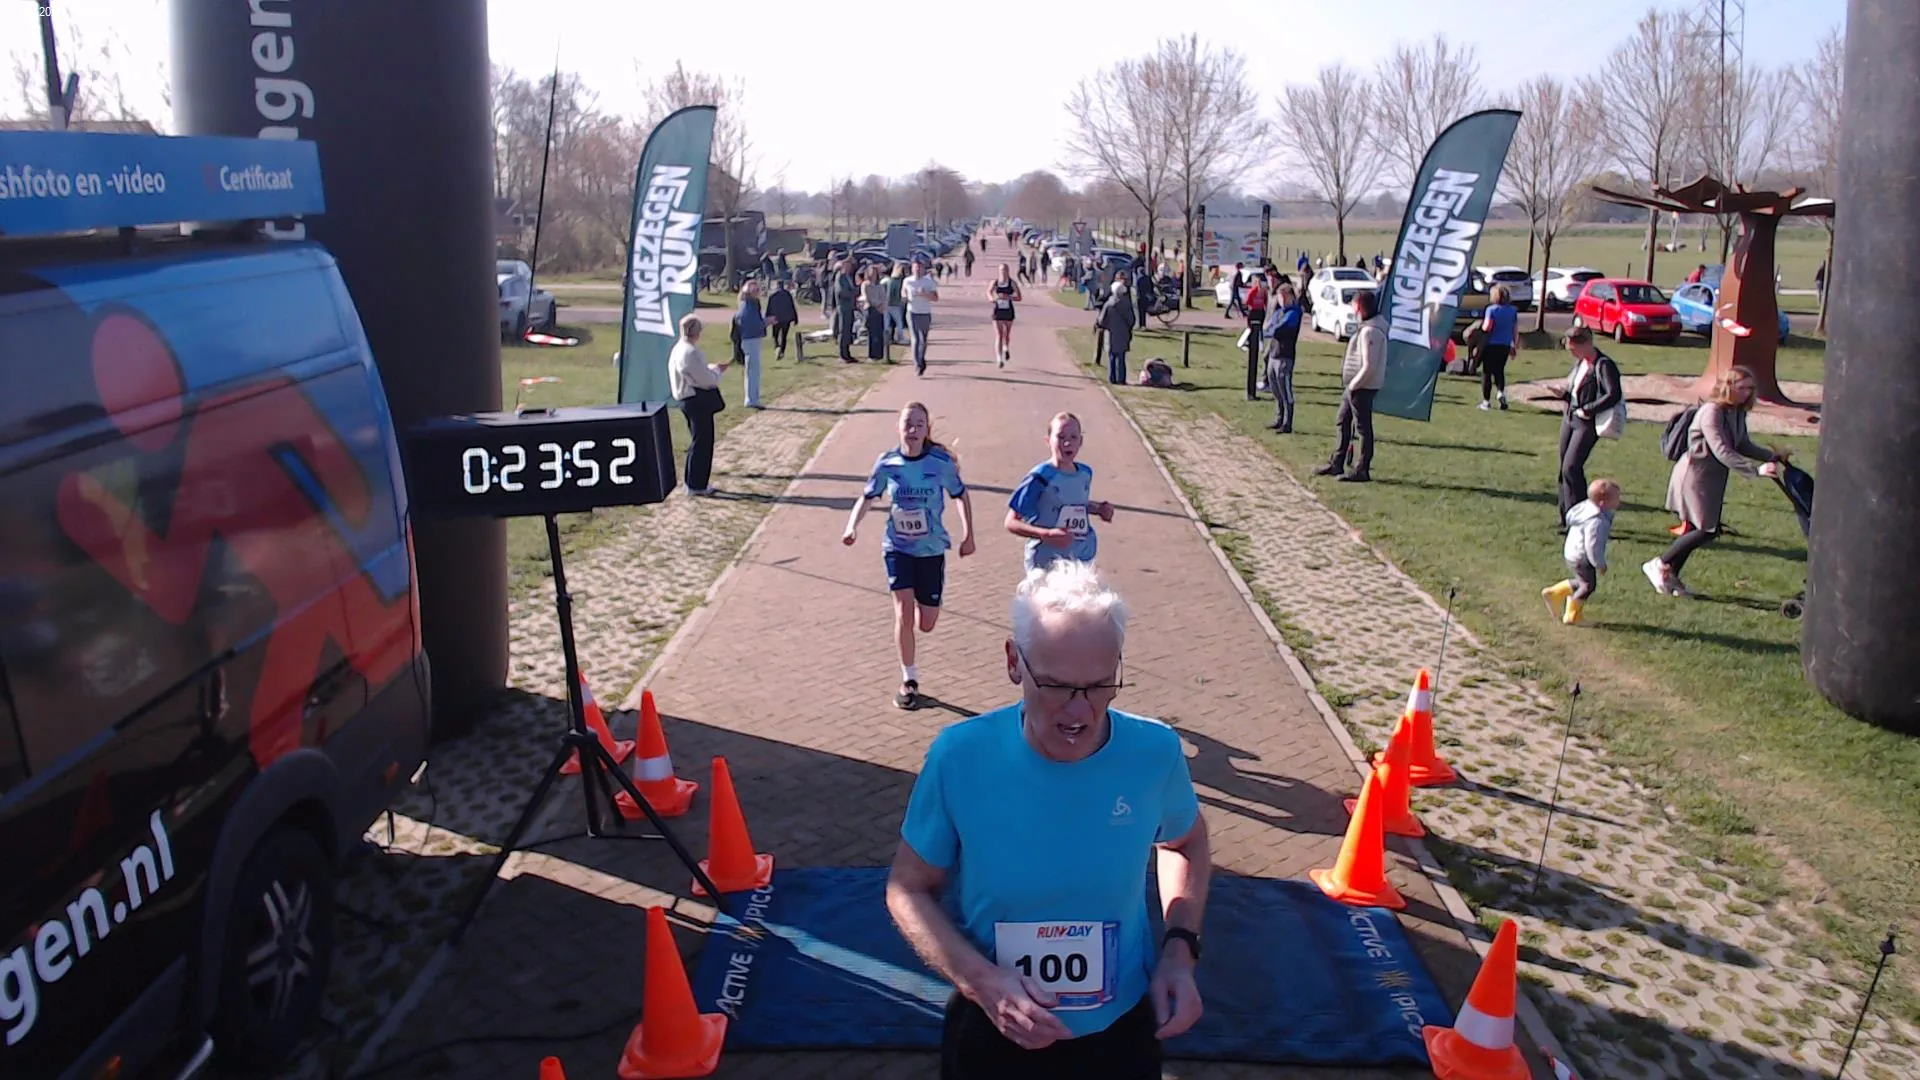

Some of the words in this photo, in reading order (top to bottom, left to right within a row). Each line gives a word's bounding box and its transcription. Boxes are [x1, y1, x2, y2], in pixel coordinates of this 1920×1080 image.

[75, 173, 102, 197] en
[106, 163, 166, 194] -video
[219, 164, 294, 192] Certificaat
[633, 164, 692, 338] LINGEZEGEN
[659, 212, 701, 296] RUN
[1388, 168, 1480, 350] LINGEZEGEN
[1424, 217, 1481, 308] RUN
[1064, 518, 1086, 530] 190
[0, 808, 175, 1046] gen.nl
[715, 951, 754, 1020] ACTIVE
[1014, 953, 1088, 983] 100
